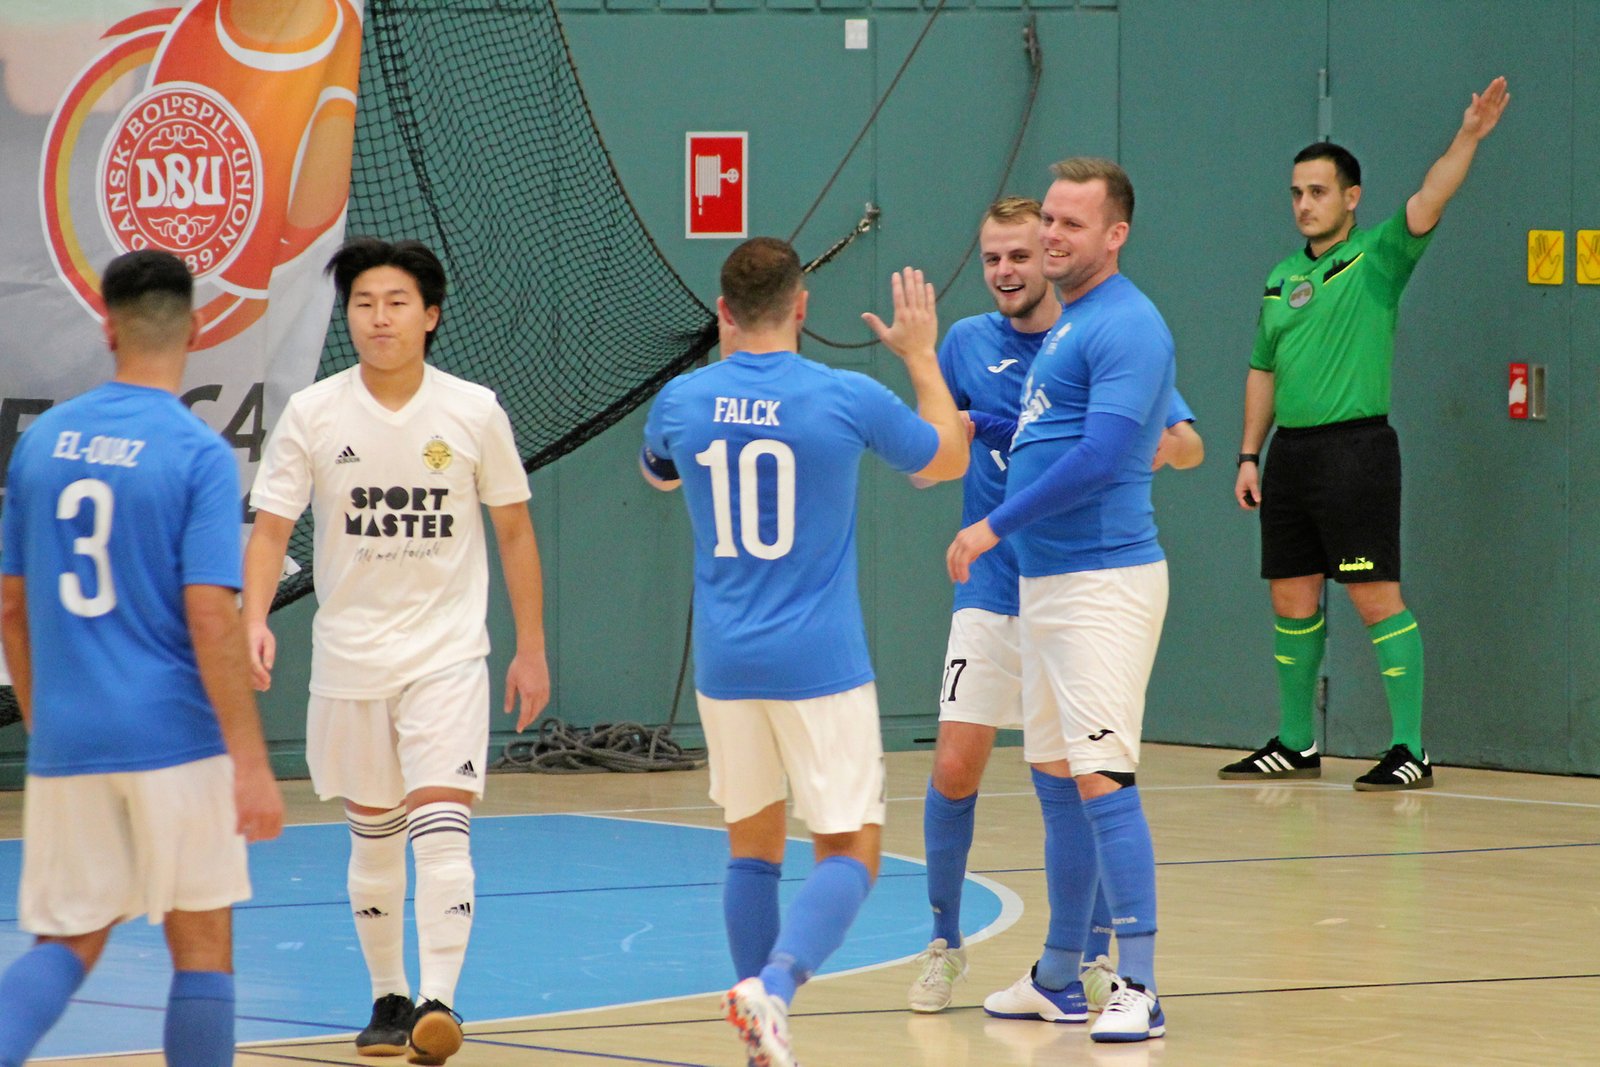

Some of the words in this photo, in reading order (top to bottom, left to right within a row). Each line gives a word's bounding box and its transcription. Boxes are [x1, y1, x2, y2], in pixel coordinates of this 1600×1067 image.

[108, 147, 149, 251] DANSK
[136, 153, 226, 209] DBU
[713, 396, 781, 427] FALCK
[344, 512, 455, 539] MASTER
[350, 486, 449, 511] SPORT
[695, 438, 796, 560] 10
[56, 478, 117, 618] 3
